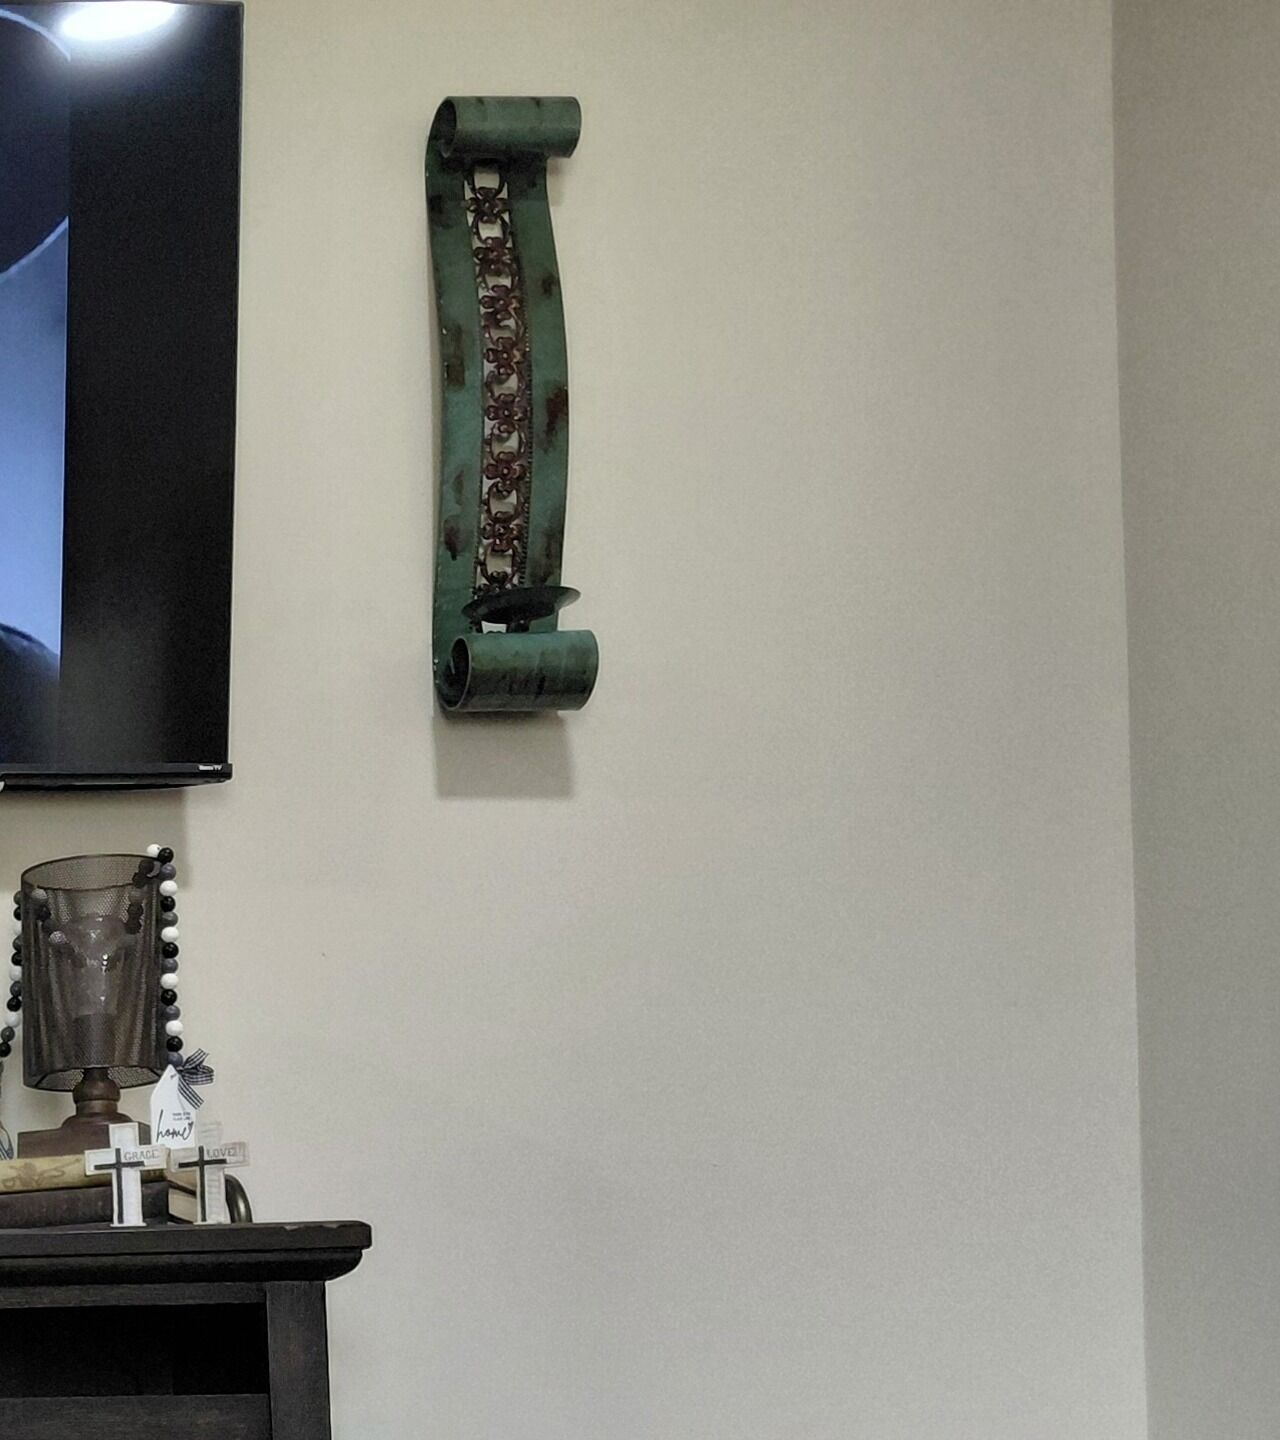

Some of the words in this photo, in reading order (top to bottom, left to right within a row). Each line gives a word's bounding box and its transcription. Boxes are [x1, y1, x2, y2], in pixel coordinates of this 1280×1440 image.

[156, 1109, 194, 1143] home
[123, 1149, 160, 1161] GRACE
[206, 1147, 237, 1158] LOVE
